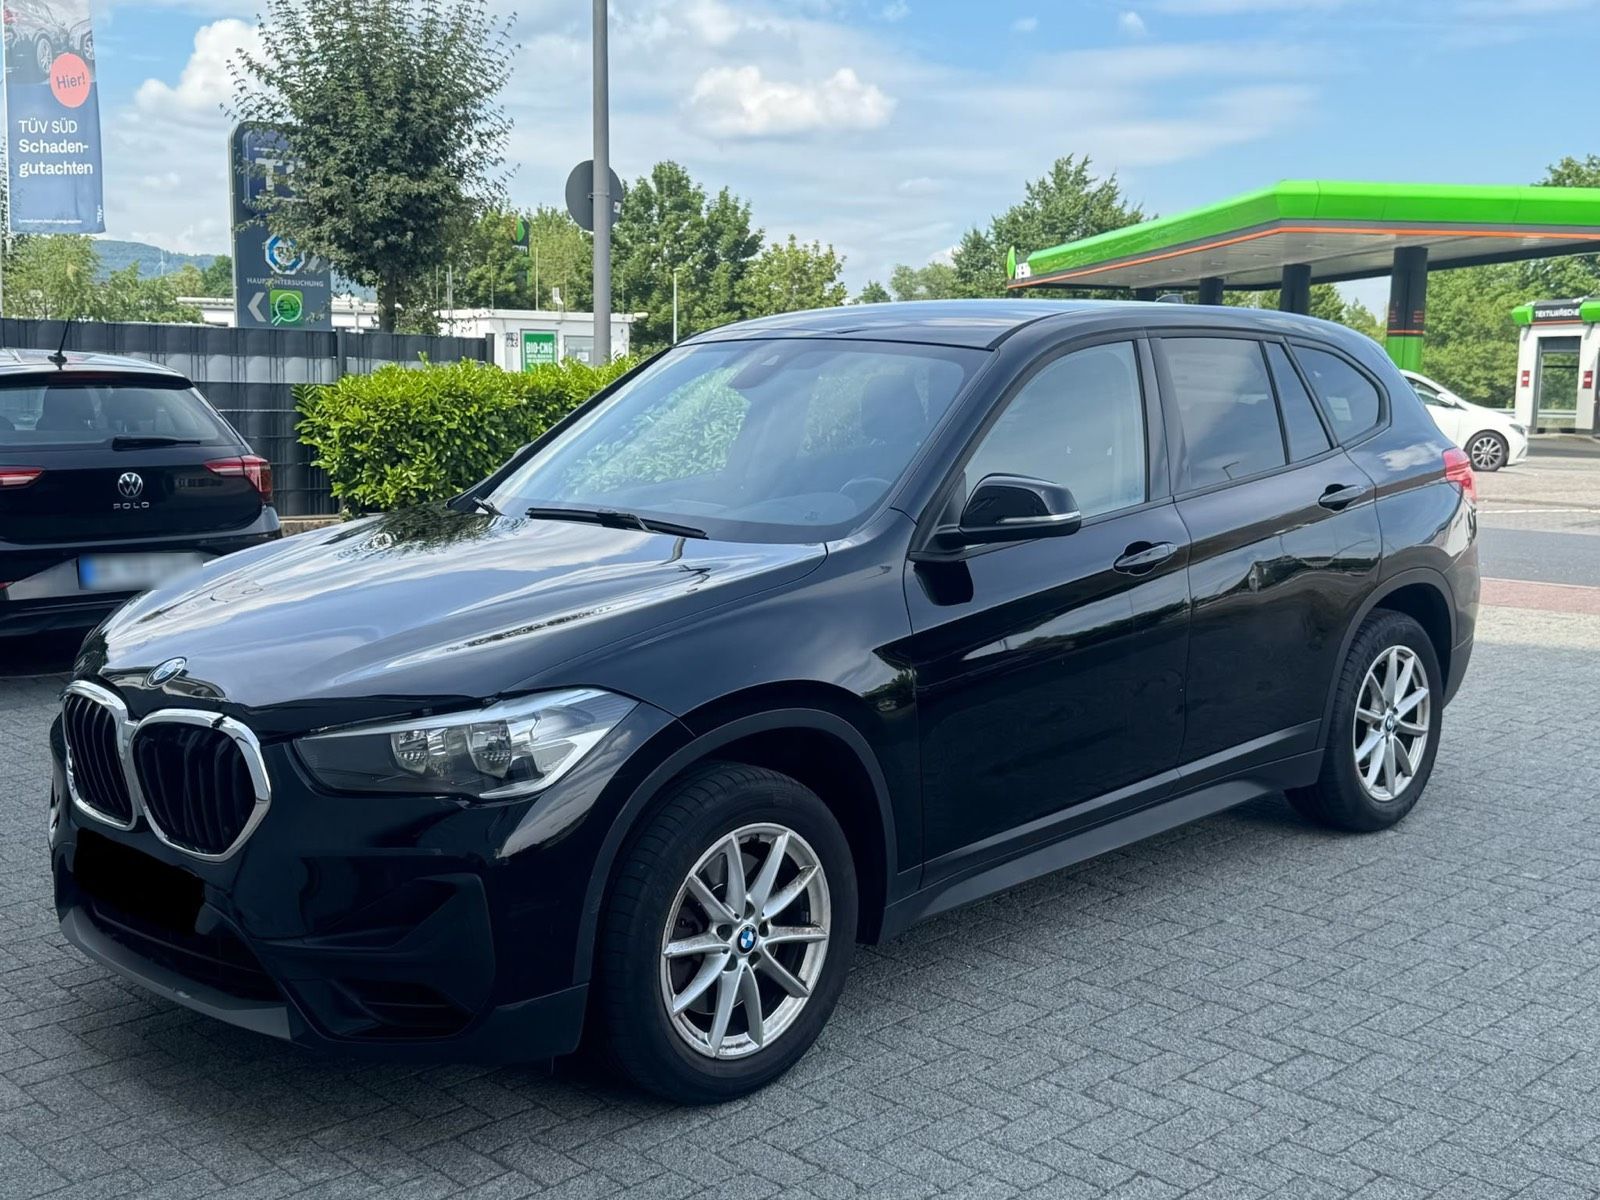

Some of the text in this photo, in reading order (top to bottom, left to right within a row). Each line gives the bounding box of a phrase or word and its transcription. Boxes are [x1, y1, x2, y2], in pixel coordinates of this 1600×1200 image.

[56, 72, 86, 89] Hier!
[18, 117, 78, 134] TÜV SÜD
[19, 139, 89, 154] Schaden-
[19, 161, 93, 178] gutachten
[525, 342, 553, 354] BIO-CNG
[113, 501, 150, 510] POLO
